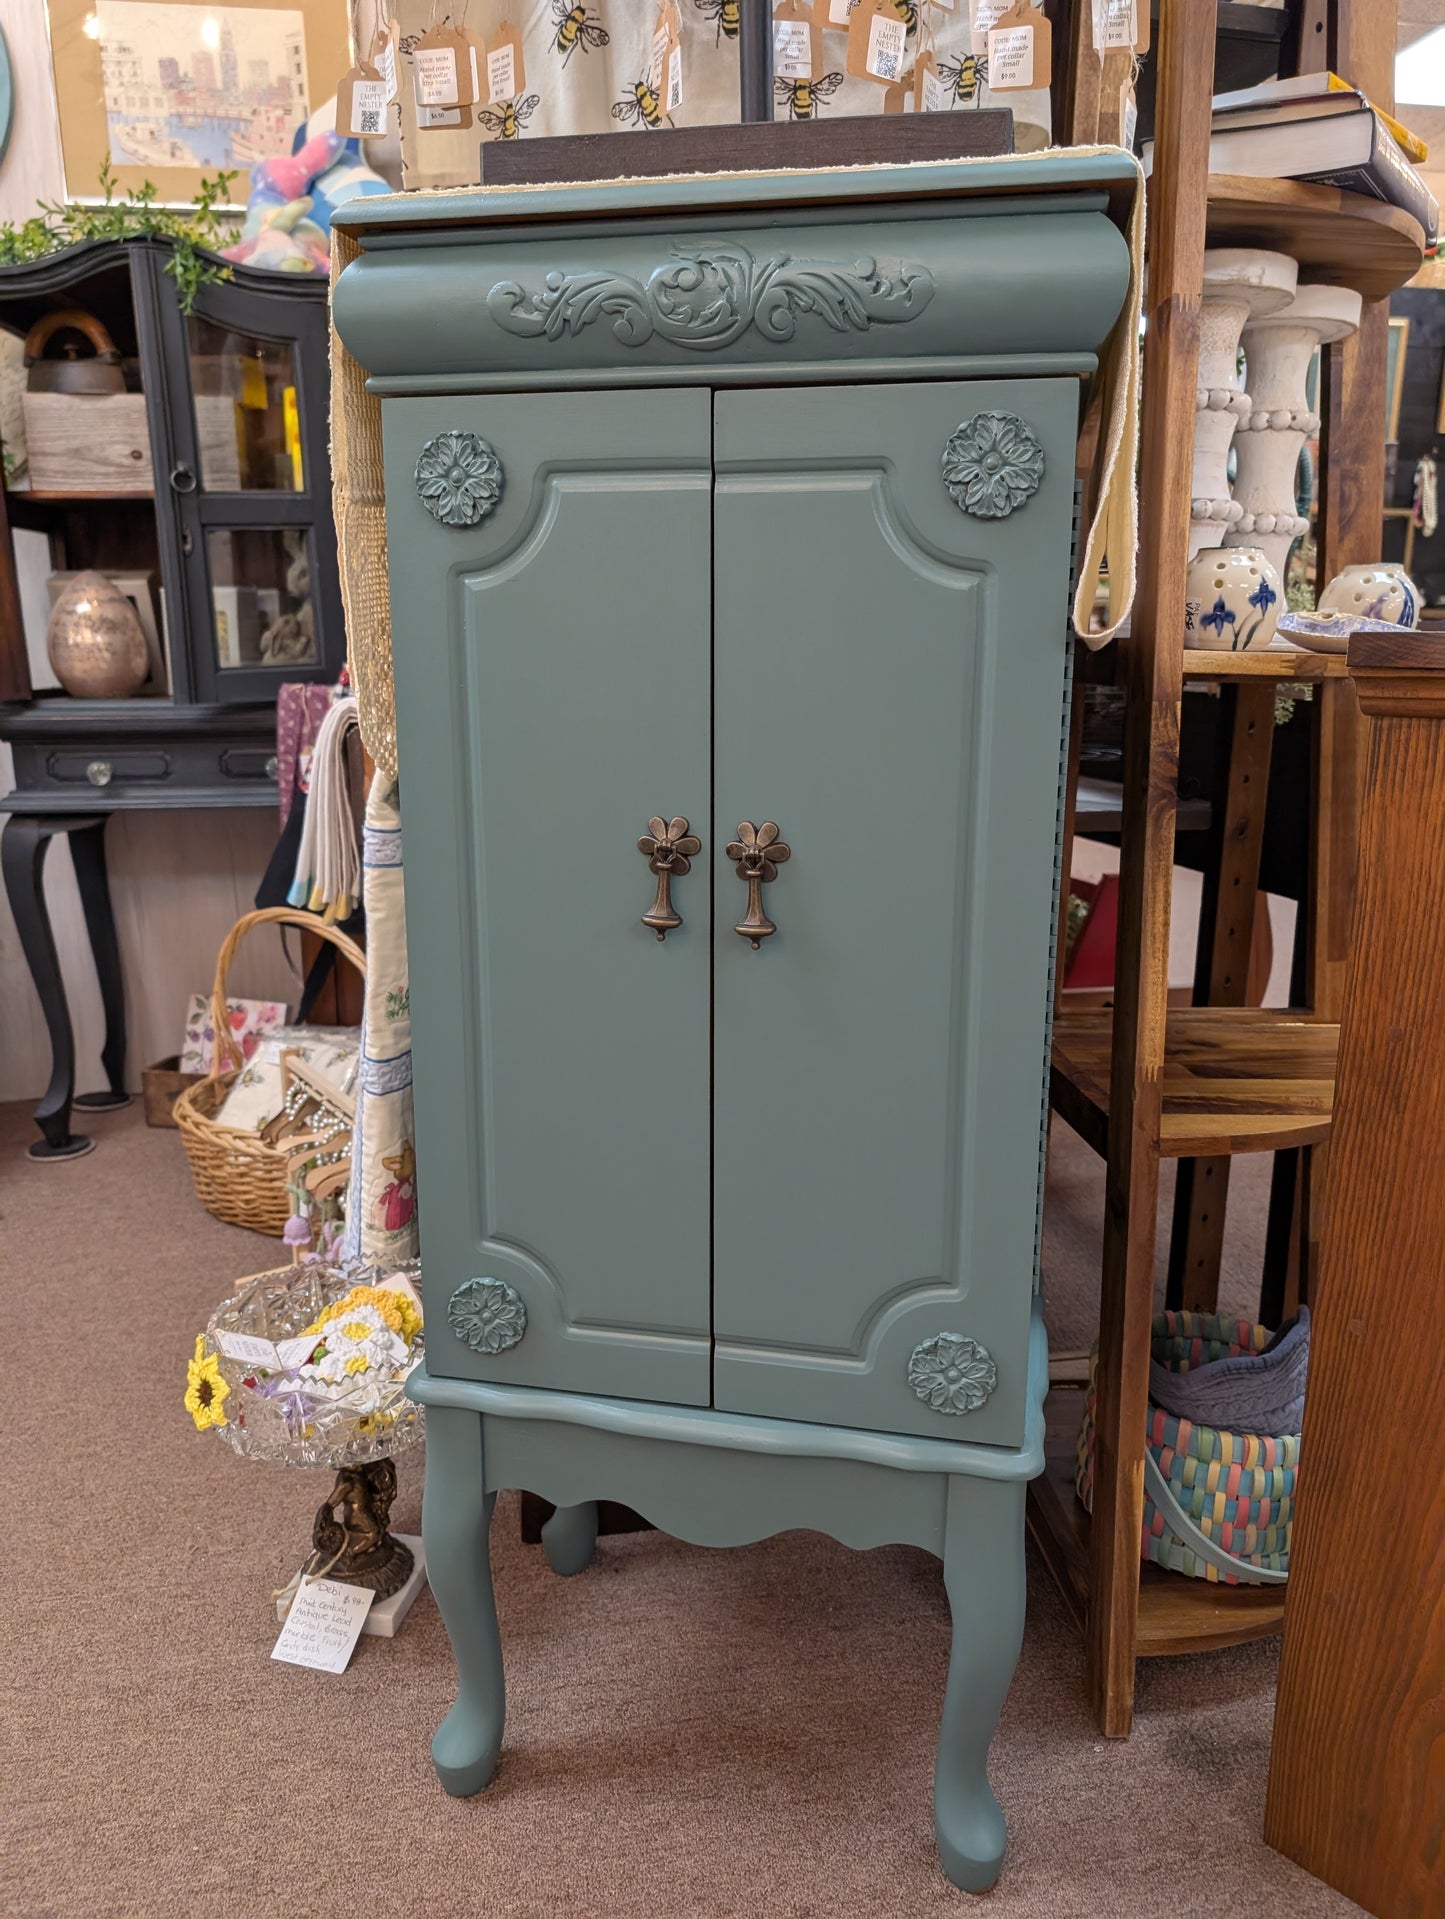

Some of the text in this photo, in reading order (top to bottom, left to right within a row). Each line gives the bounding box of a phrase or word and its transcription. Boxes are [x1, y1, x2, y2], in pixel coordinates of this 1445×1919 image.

[884, 22, 899, 34] THE
[1108, 20, 1126, 28] Small
[878, 31, 901, 44] EMPTY
[875, 39, 902, 53] NESTER
[993, 44, 1029, 55] Hand made
[996, 52, 1026, 62] pet collar
[1001, 60, 1021, 68] Small
[1000, 73, 1017, 81] $9.00
[365, 85, 377, 93] THE
[359, 101, 383, 109] NESTER
[316, 1582, 343, 1596] Debi
[295, 1607, 329, 1621] Antique
